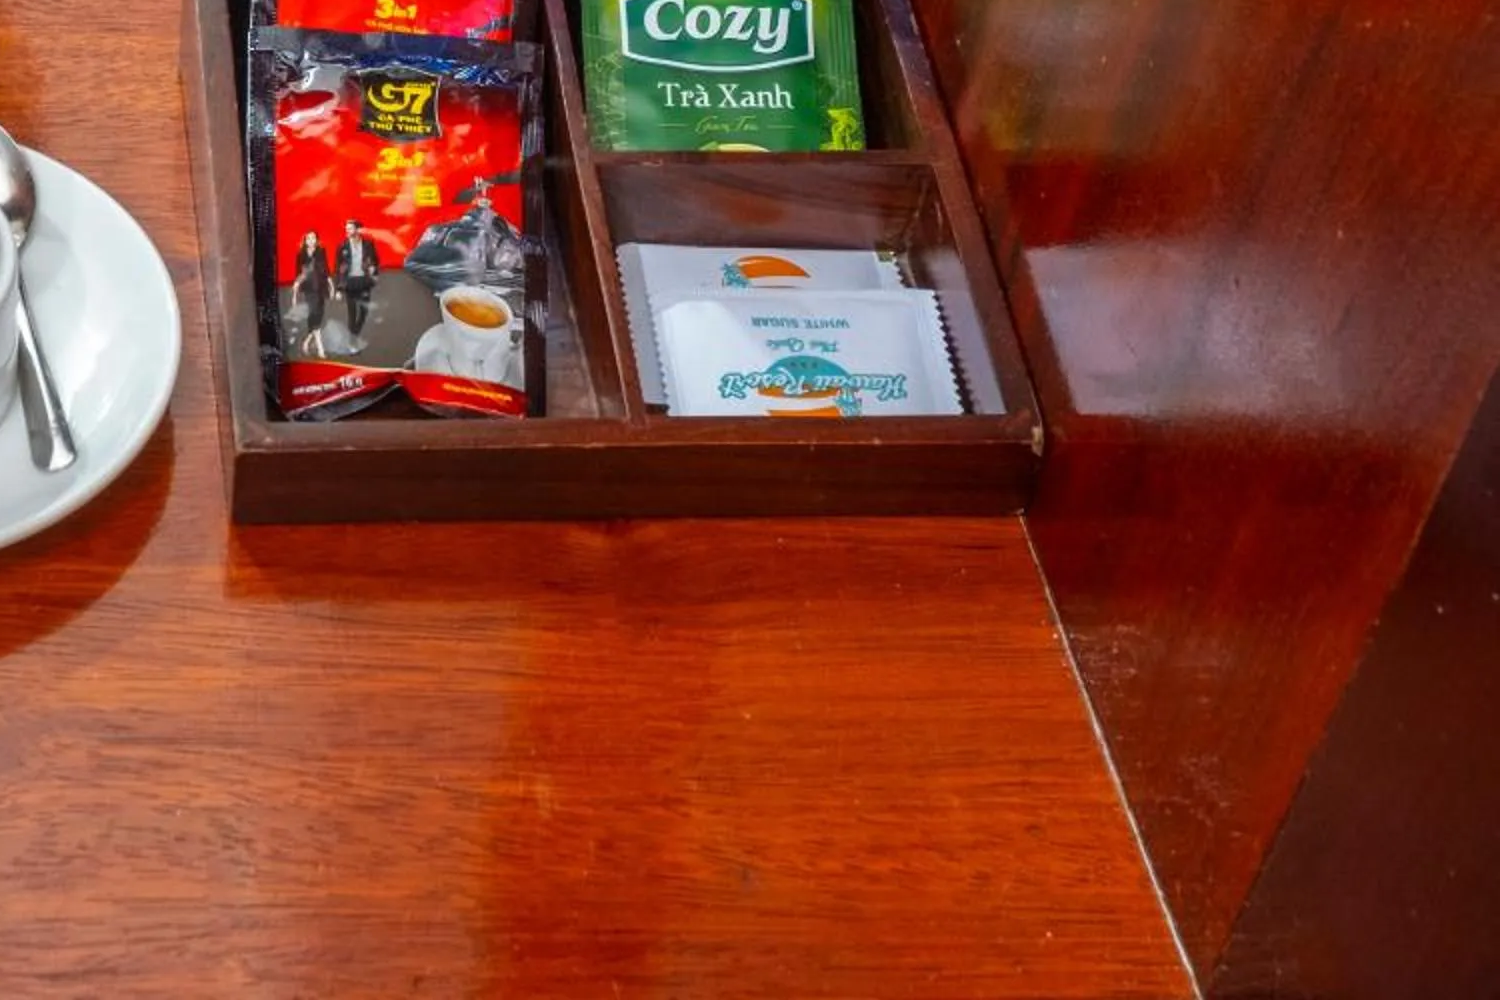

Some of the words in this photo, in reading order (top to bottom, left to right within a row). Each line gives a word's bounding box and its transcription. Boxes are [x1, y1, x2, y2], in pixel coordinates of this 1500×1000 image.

[367, 82, 432, 114] G7
[657, 81, 711, 107] Trà
[717, 83, 795, 109] Xanh
[751, 316, 799, 328] SUGAR
[803, 317, 850, 329] WHITE
[719, 368, 808, 399] Resort
[812, 373, 908, 401] Hawaii
